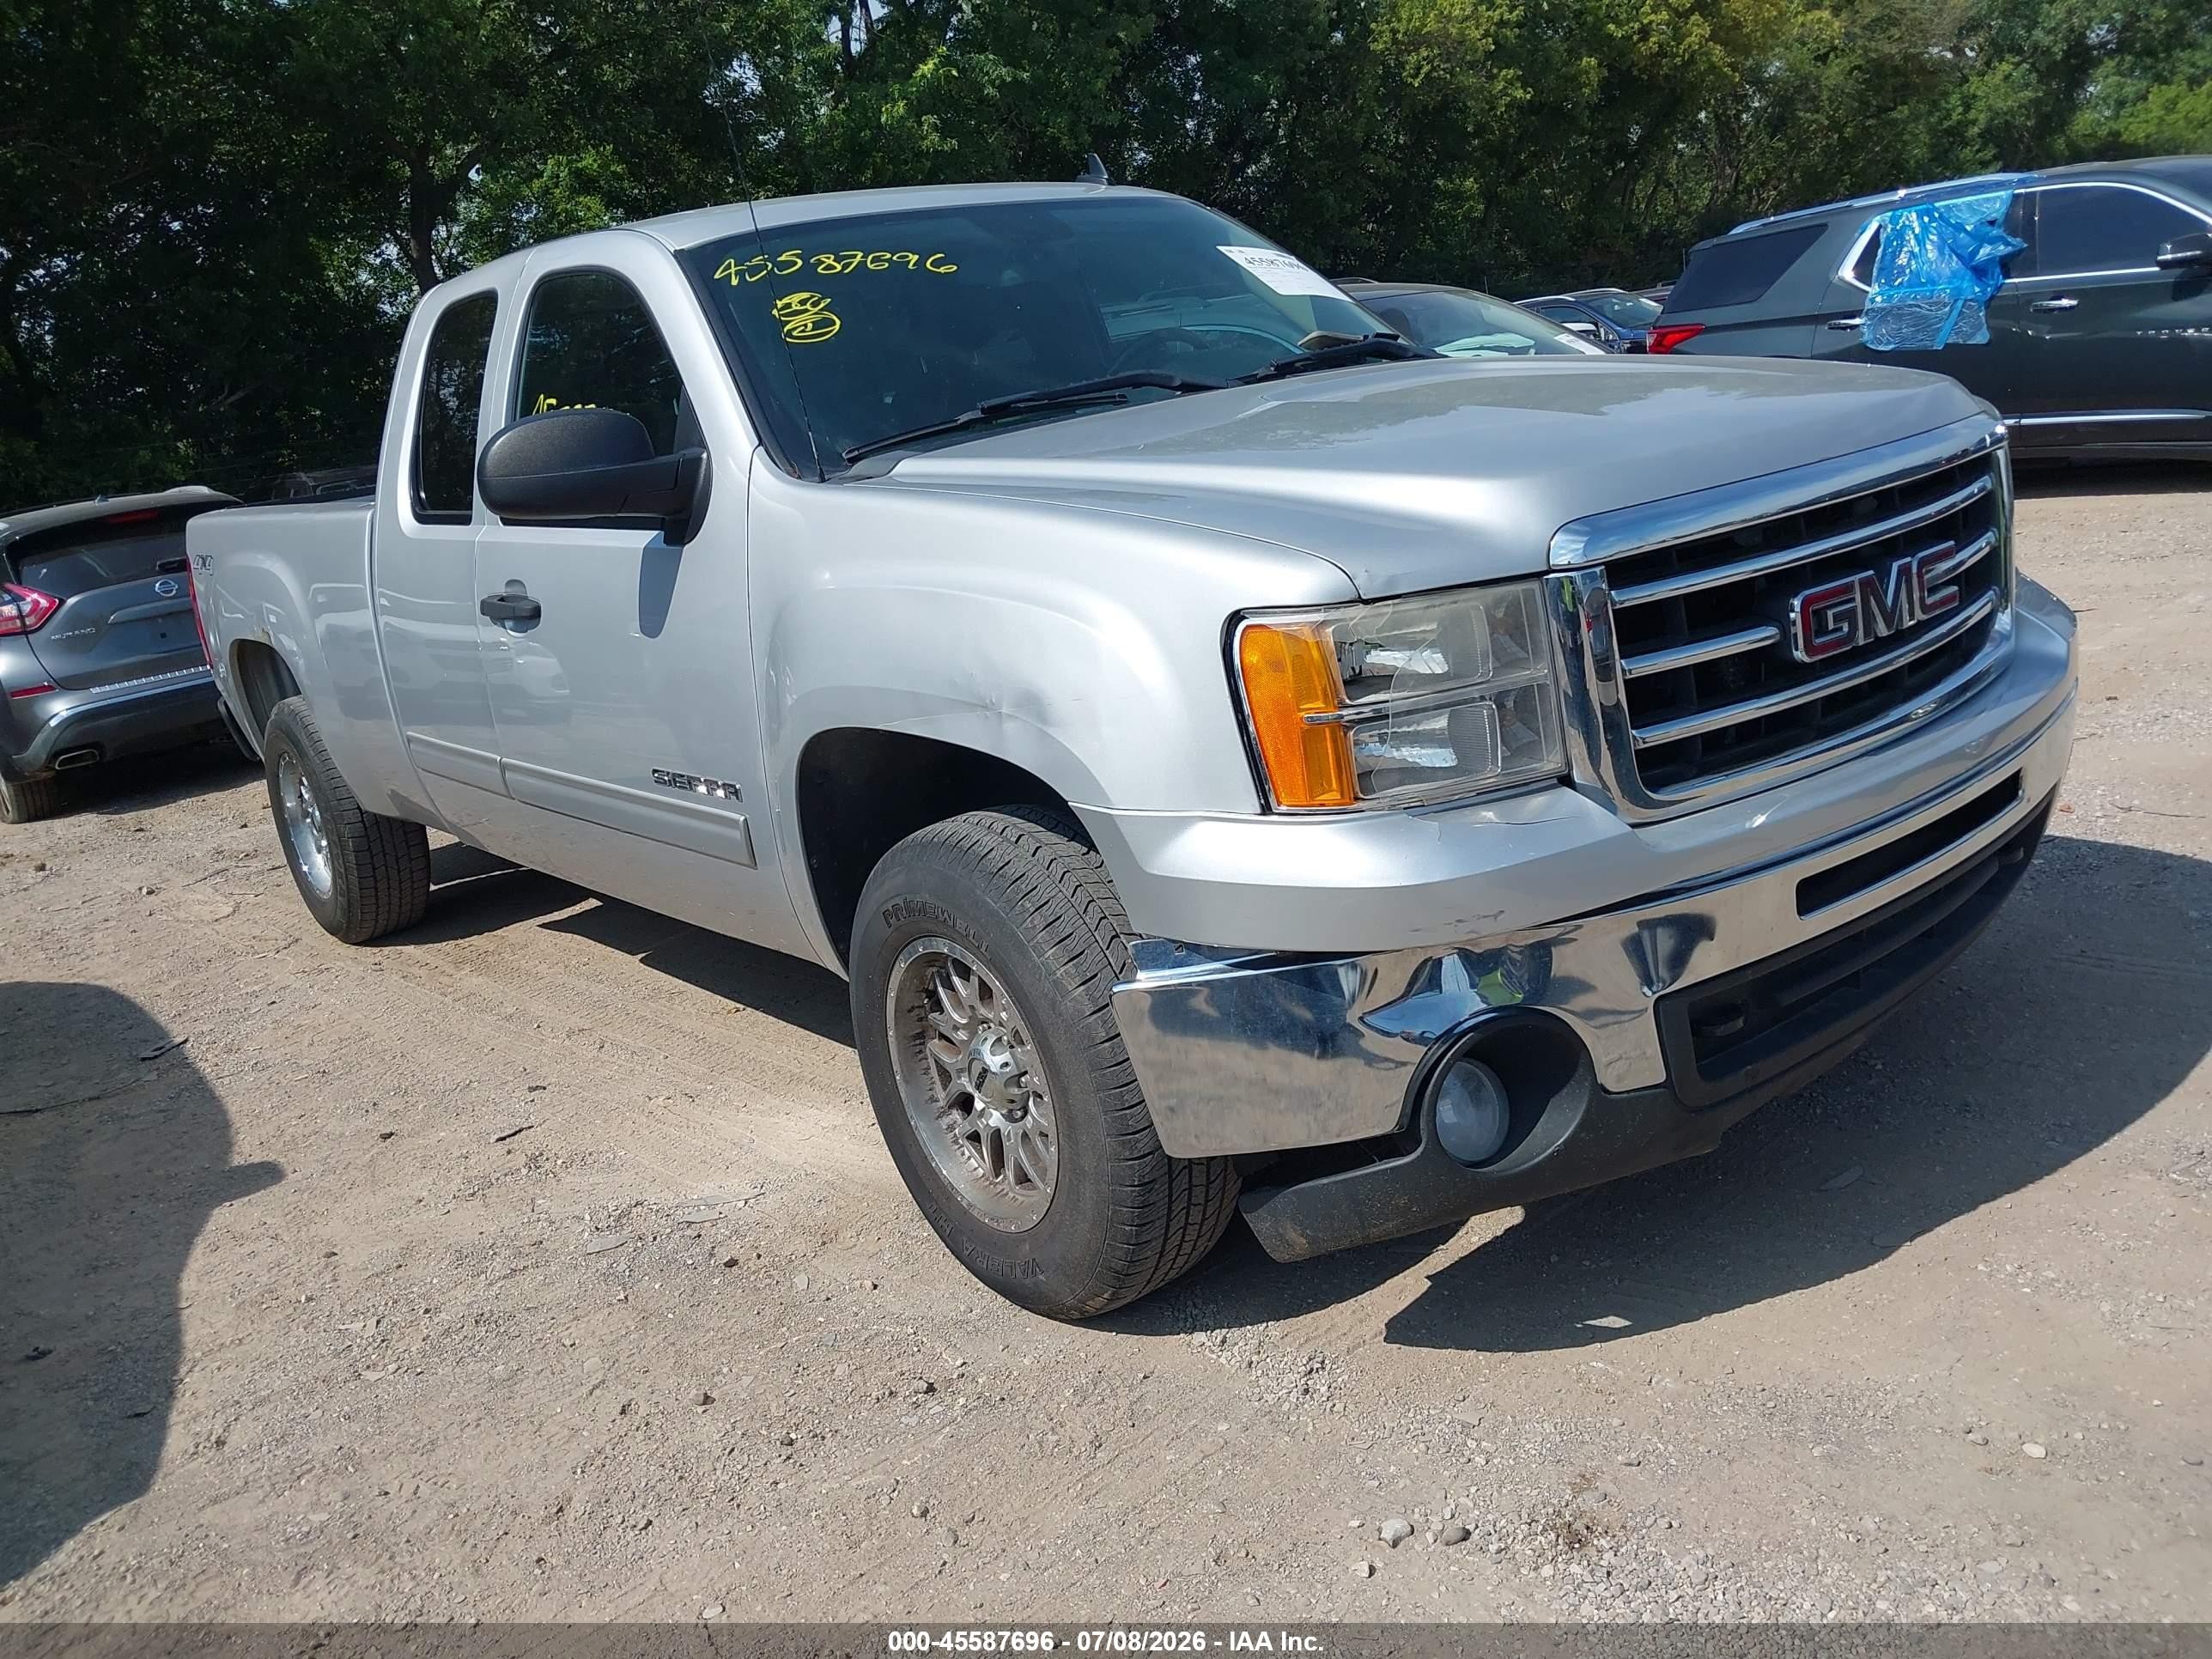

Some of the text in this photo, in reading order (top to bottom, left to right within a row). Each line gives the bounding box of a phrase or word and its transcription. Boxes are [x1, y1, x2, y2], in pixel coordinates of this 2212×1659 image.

[714, 250, 958, 286] 45587696
[1789, 539, 1960, 664] GMC
[651, 767, 744, 804] SIERRA
